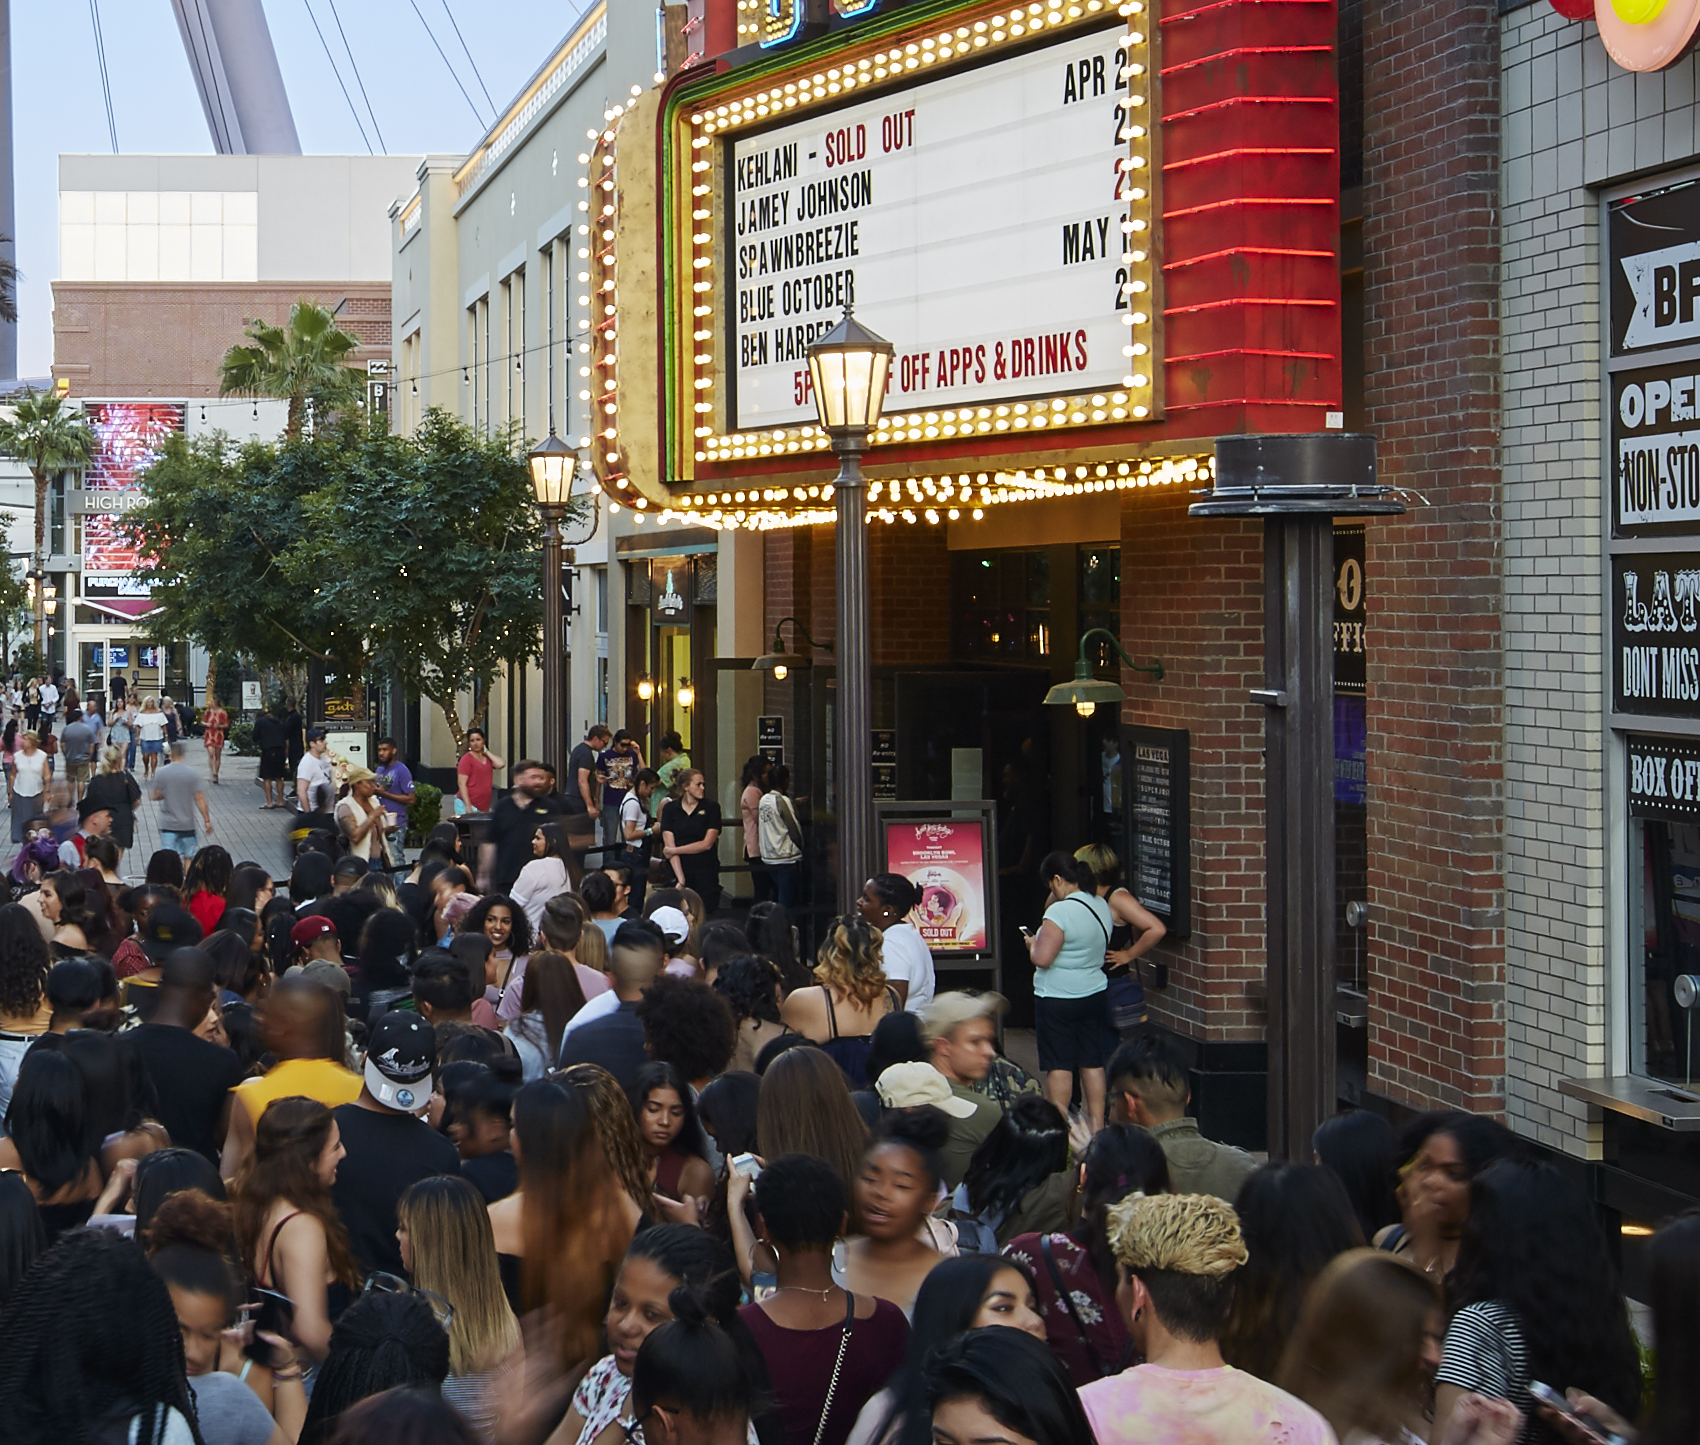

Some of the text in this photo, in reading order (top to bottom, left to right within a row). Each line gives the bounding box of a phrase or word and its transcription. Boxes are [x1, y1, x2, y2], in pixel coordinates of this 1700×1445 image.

[737, 142, 798, 192] KEHLANI
[825, 124, 867, 168] SOLD
[882, 109, 916, 153] OUT
[1063, 55, 1106, 105] APR
[737, 190, 790, 237] JAMEY
[797, 169, 873, 221] JOHNSON
[739, 220, 860, 280] SPAWNBREEZIE
[740, 283, 775, 324] BLUE
[782, 269, 855, 316] OCTOBER
[1062, 216, 1110, 266] MAY
[741, 330, 768, 368] BEN
[900, 352, 931, 393] OFF
[937, 343, 987, 389] APPS
[1011, 329, 1088, 379] DRINKS
[85, 495, 150, 510] HIGH RO
[1624, 443, 1700, 513] NON-STO
[1622, 645, 1700, 702] DONT MISS
[1137, 747, 1150, 759] LAS
[1630, 754, 1668, 798] BOX
[922, 927, 954, 938] SOLD OUT
